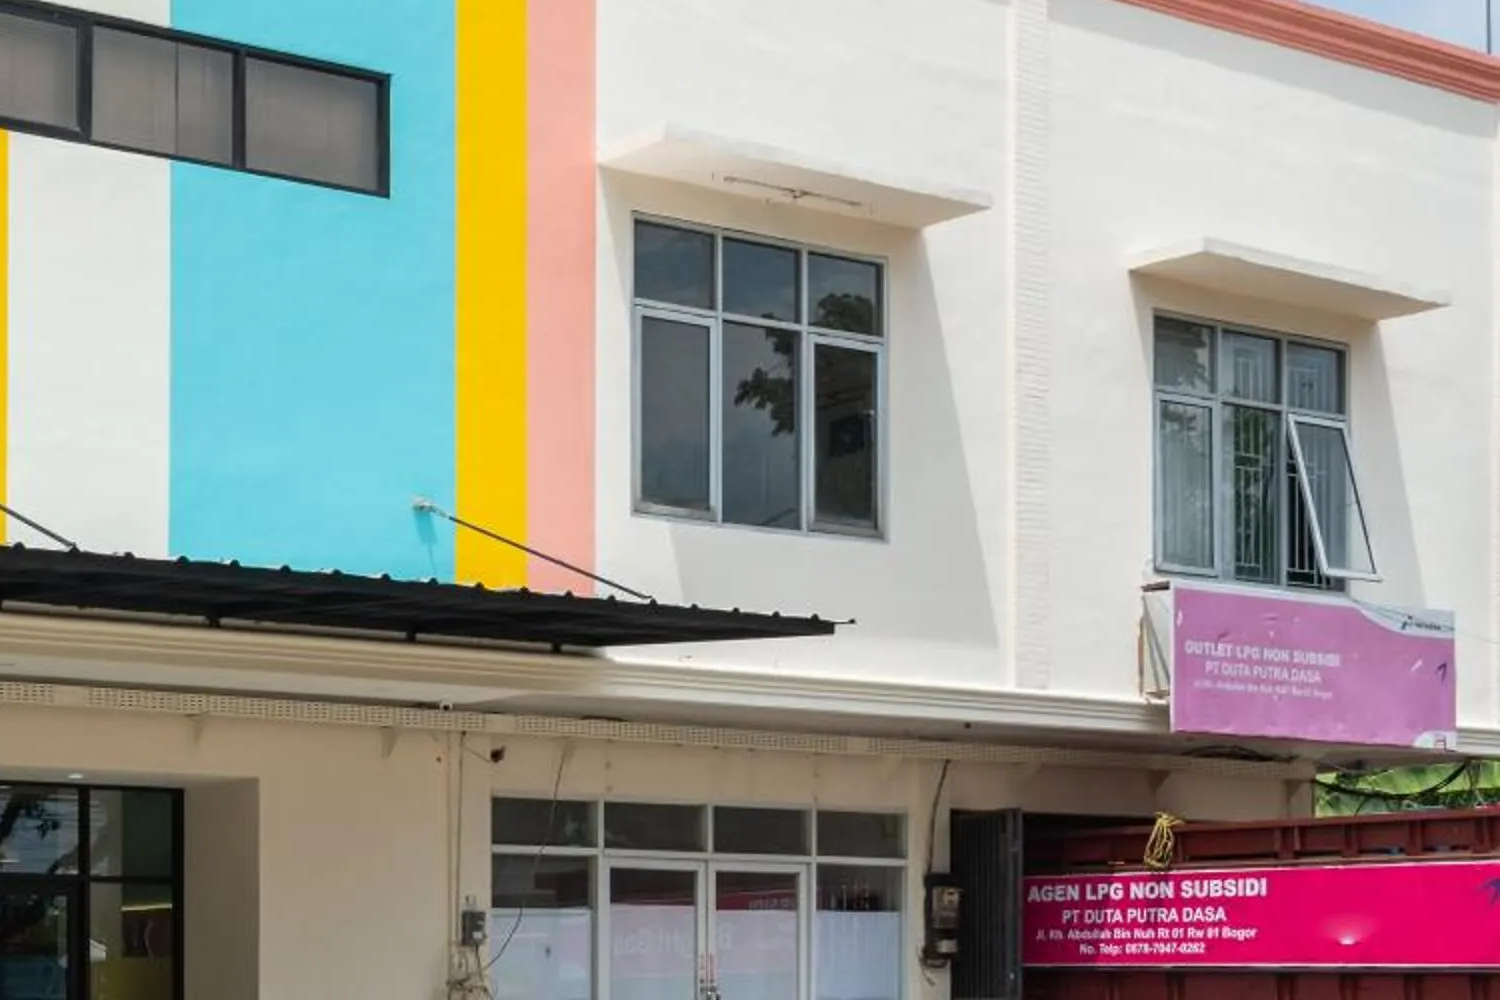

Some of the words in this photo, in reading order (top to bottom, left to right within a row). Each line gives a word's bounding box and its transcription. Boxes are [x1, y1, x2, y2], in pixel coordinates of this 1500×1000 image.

[1185, 640, 1233, 658] OUTLET
[1236, 644, 1261, 660] LPG
[1263, 647, 1290, 662] NON
[1205, 661, 1220, 674] PT
[1221, 662, 1250, 677] DUTA
[1253, 665, 1288, 680] PUTRA
[1290, 668, 1322, 683] DASA
[1028, 885, 1079, 902] AGEN
[1085, 882, 1124, 901] LPG
[1129, 880, 1174, 900] NON
[1181, 877, 1267, 898] SUBSIDI
[1062, 909, 1080, 924] PT
[1084, 908, 1123, 924] DUTA
[1127, 907, 1179, 923] PUTRA
[1182, 906, 1227, 922] DASA
[1113, 928, 1131, 939] Bin
[1133, 928, 1155, 939] Nuh
[1157, 927, 1170, 938] Rt
[1187, 927, 1204, 938] Rw
[1221, 926, 1258, 941] Bogor
